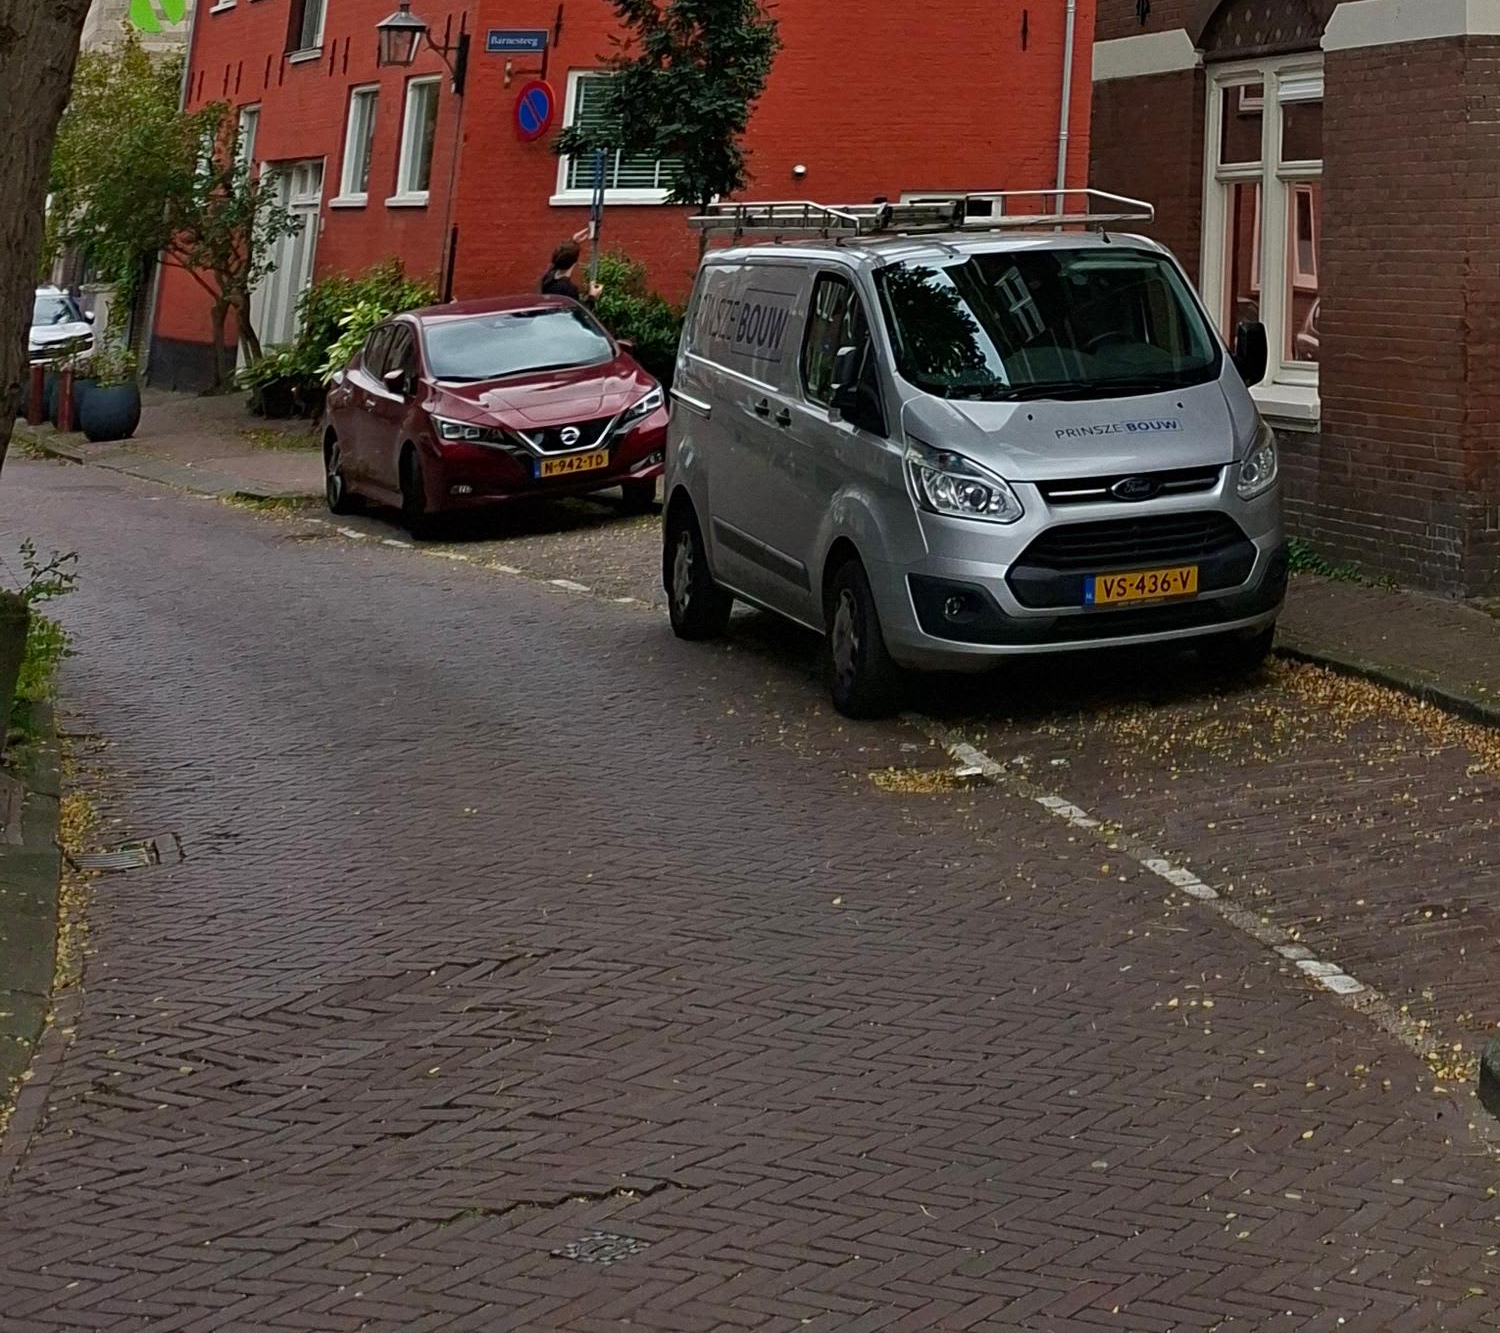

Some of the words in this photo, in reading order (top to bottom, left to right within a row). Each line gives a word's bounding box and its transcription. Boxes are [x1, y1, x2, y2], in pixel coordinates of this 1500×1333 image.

[736, 303, 789, 350] BOUW
[1055, 424, 1122, 439] PRINSZE
[1126, 421, 1177, 432] BOUW
[544, 454, 604, 474] N-942-TD
[1103, 571, 1190, 598] VS-436-V
